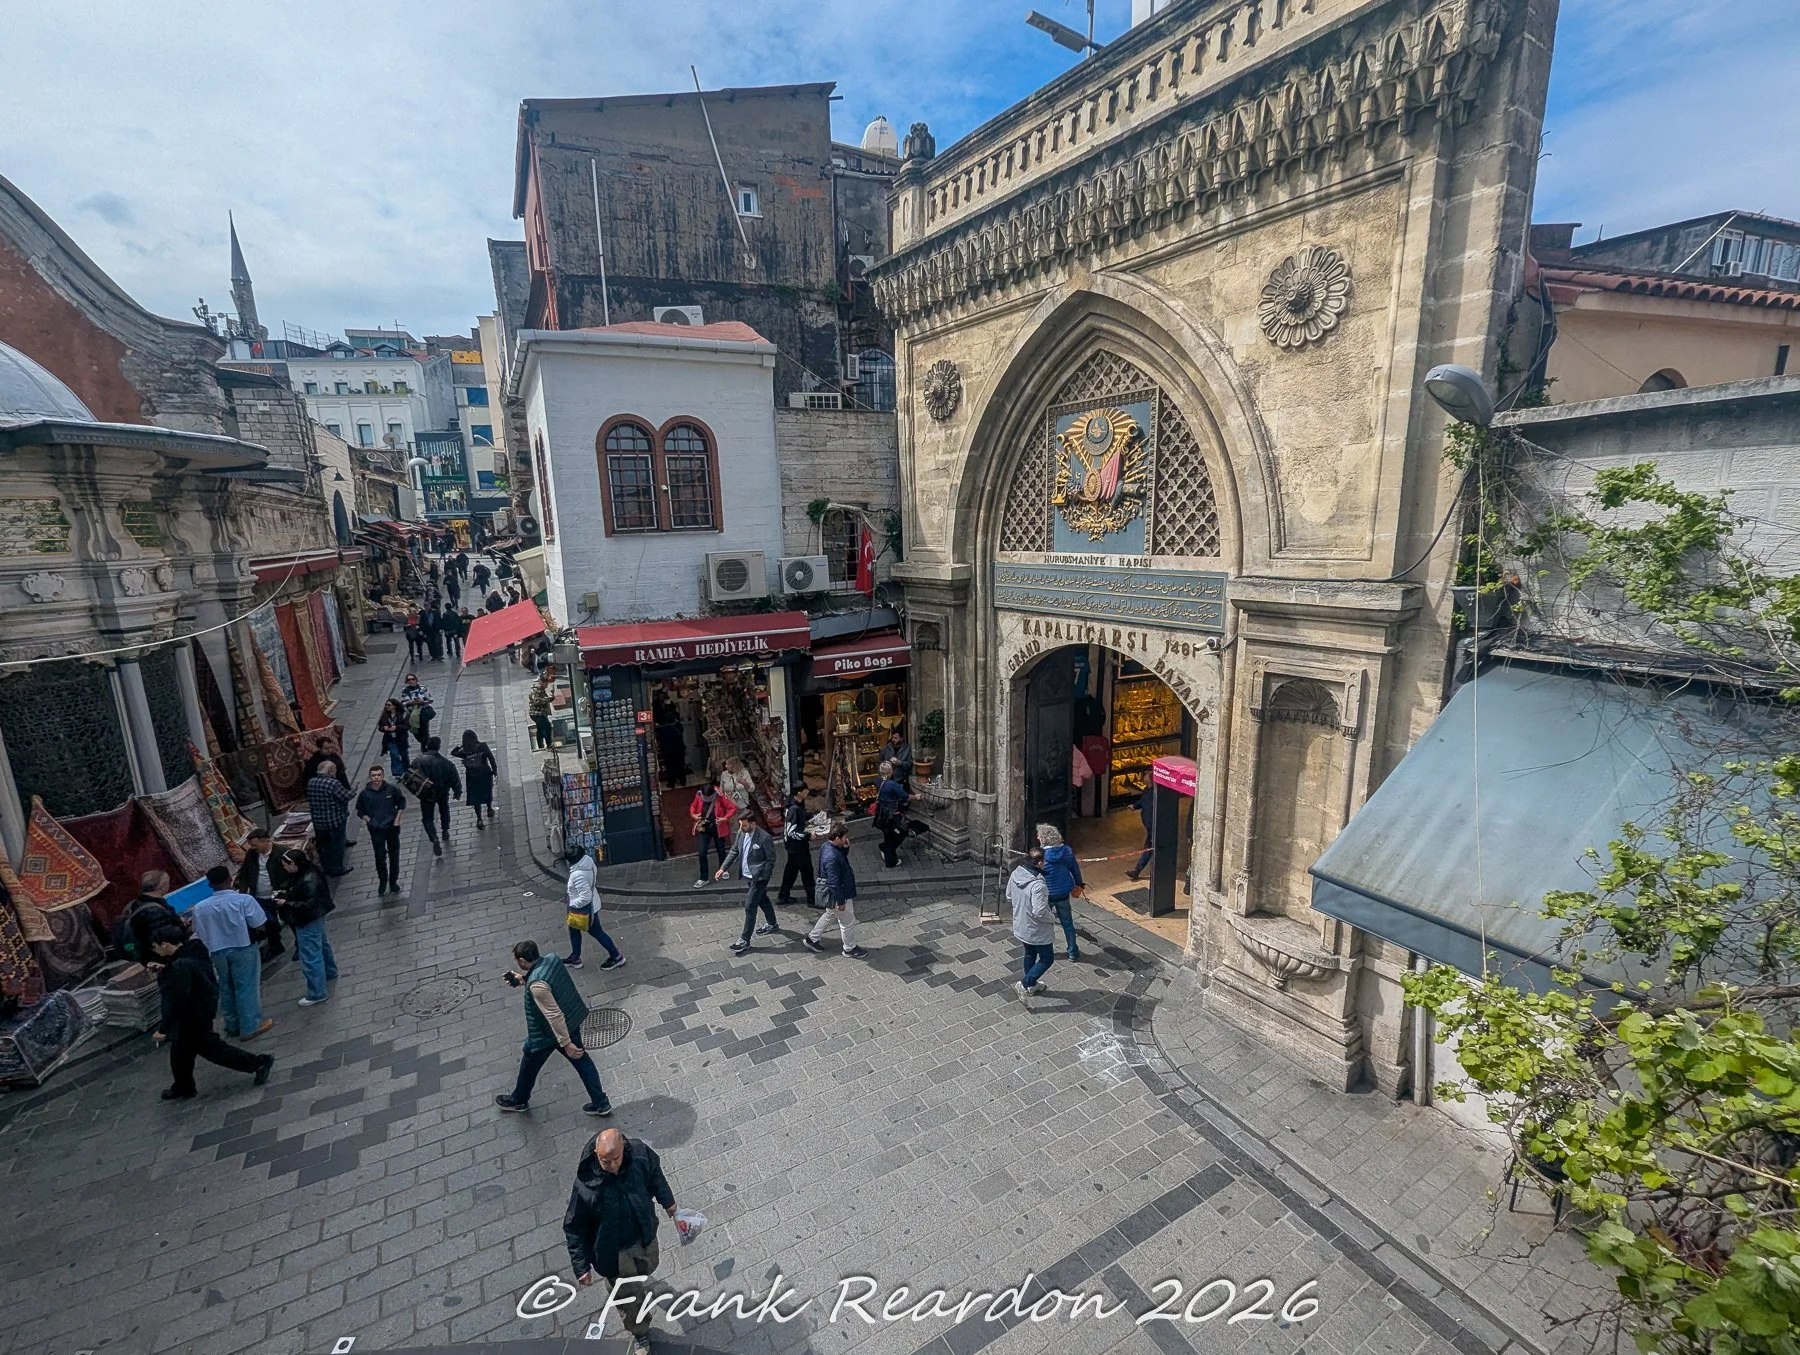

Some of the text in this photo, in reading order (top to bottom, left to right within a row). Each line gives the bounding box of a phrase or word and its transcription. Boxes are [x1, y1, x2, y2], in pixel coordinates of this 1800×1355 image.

[1119, 557, 1153, 568] KAPISI
[695, 635, 770, 656] HEDİYELİK
[1022, 618, 1148, 653] KAPALIÇARŞI
[834, 656, 893, 671] Piko Bags
[1007, 640, 1210, 723] GRAND BAZAAR
